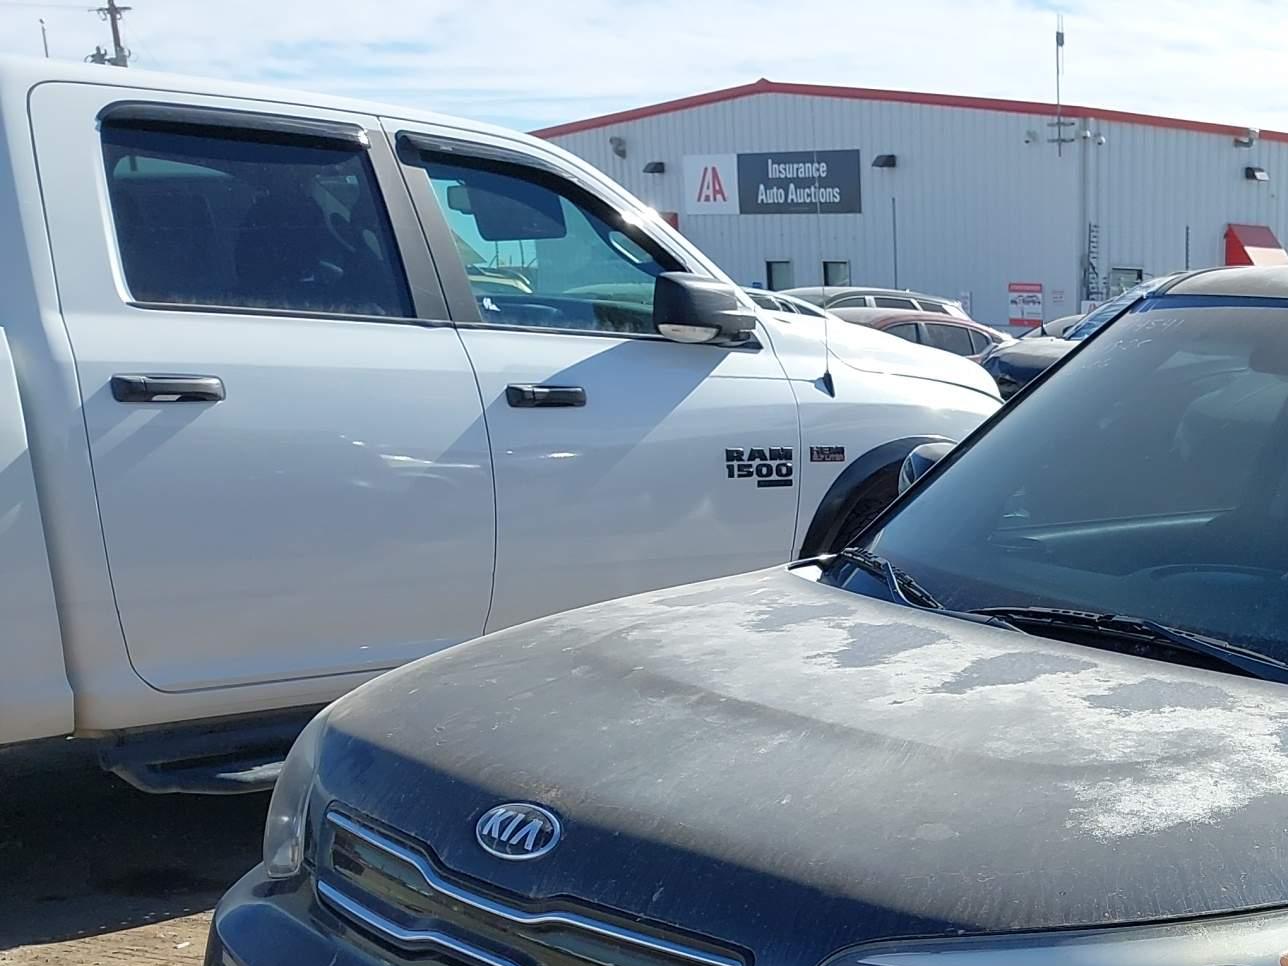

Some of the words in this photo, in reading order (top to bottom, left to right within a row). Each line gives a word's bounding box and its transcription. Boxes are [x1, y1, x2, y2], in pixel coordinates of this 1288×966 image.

[768, 159, 827, 178] Insurance
[758, 184, 785, 203] Auto
[788, 183, 840, 203] Auctions
[725, 447, 793, 462] RAM
[726, 463, 793, 478] 1500
[482, 808, 543, 852] KIA
